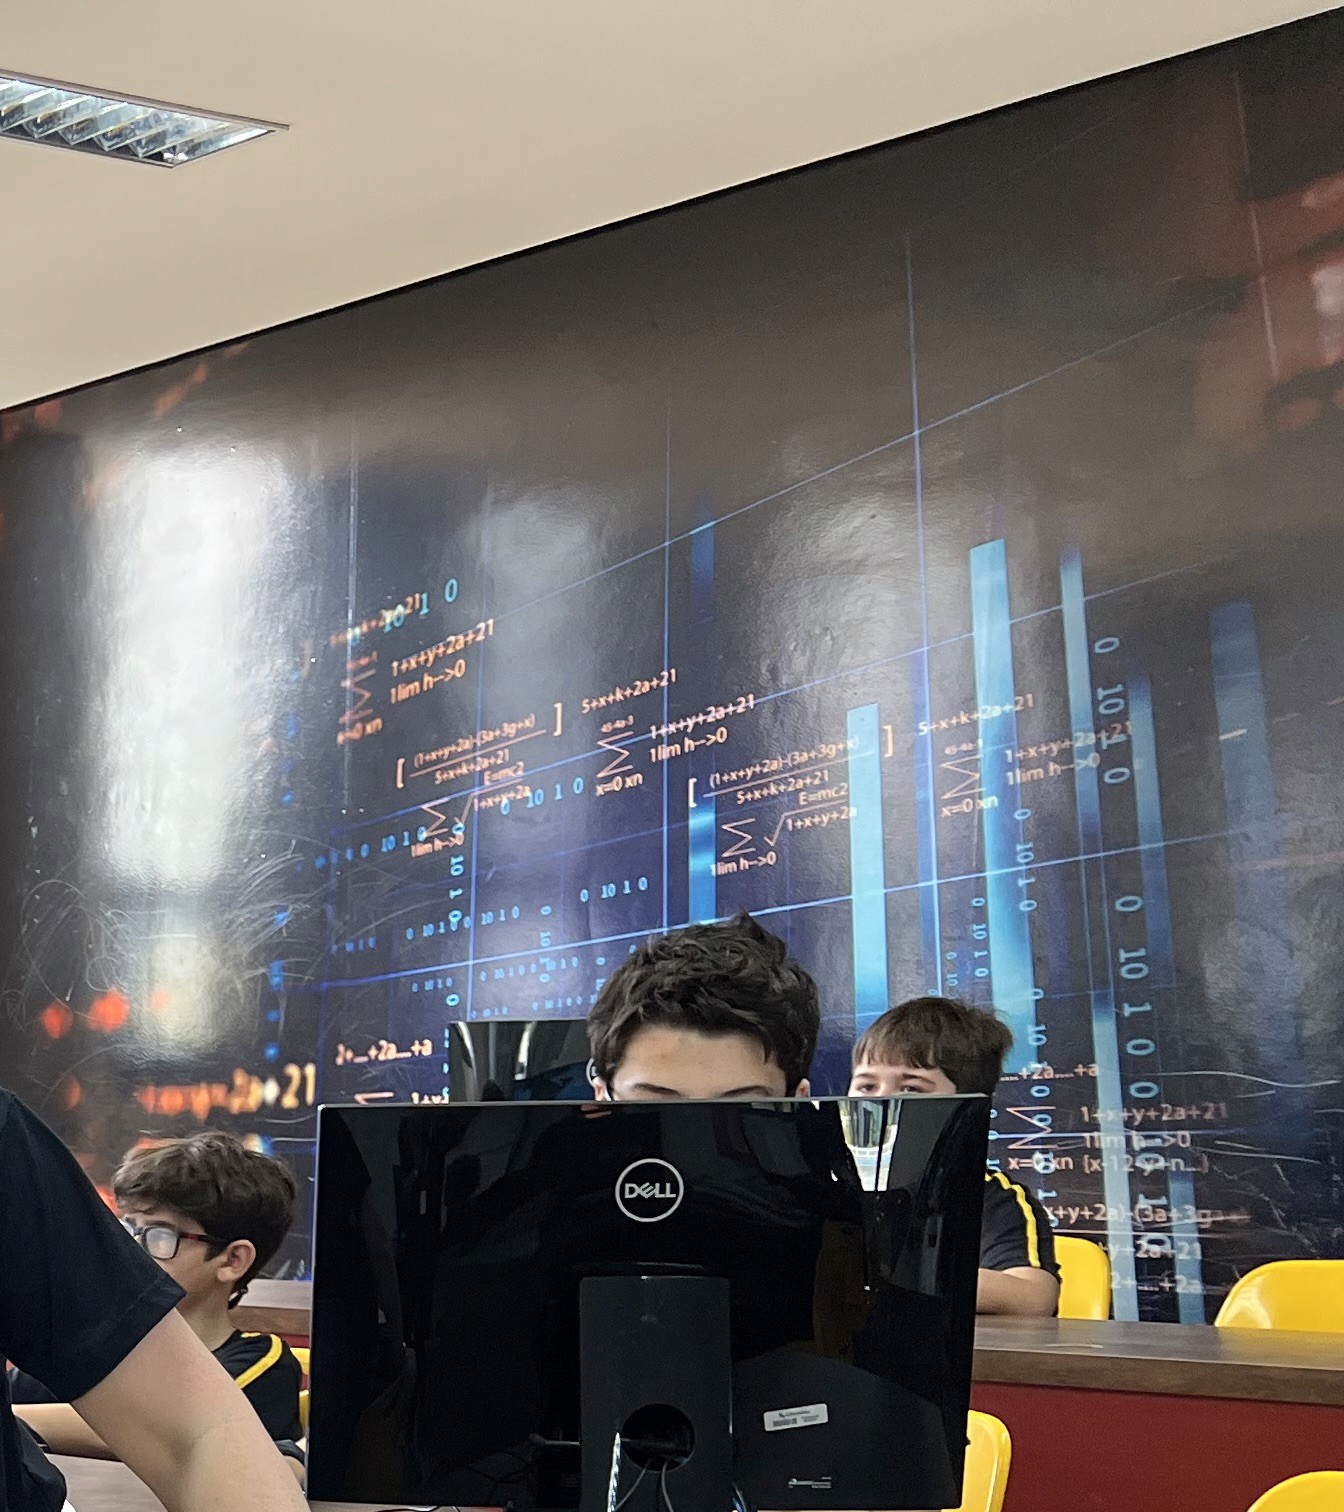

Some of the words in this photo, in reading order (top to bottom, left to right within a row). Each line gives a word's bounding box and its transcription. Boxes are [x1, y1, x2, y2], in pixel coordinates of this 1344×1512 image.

[445, 578, 458, 603] 0
[1094, 637, 1120, 654] 0
[1097, 683, 1125, 715] 10
[1103, 767, 1131, 784] 0
[1115, 895, 1143, 912] 0
[1119, 947, 1150, 979] 10
[1126, 1038, 1156, 1056] 0
[1129, 1081, 1160, 1099] 0
[624, 1182, 677, 1199] DELL
